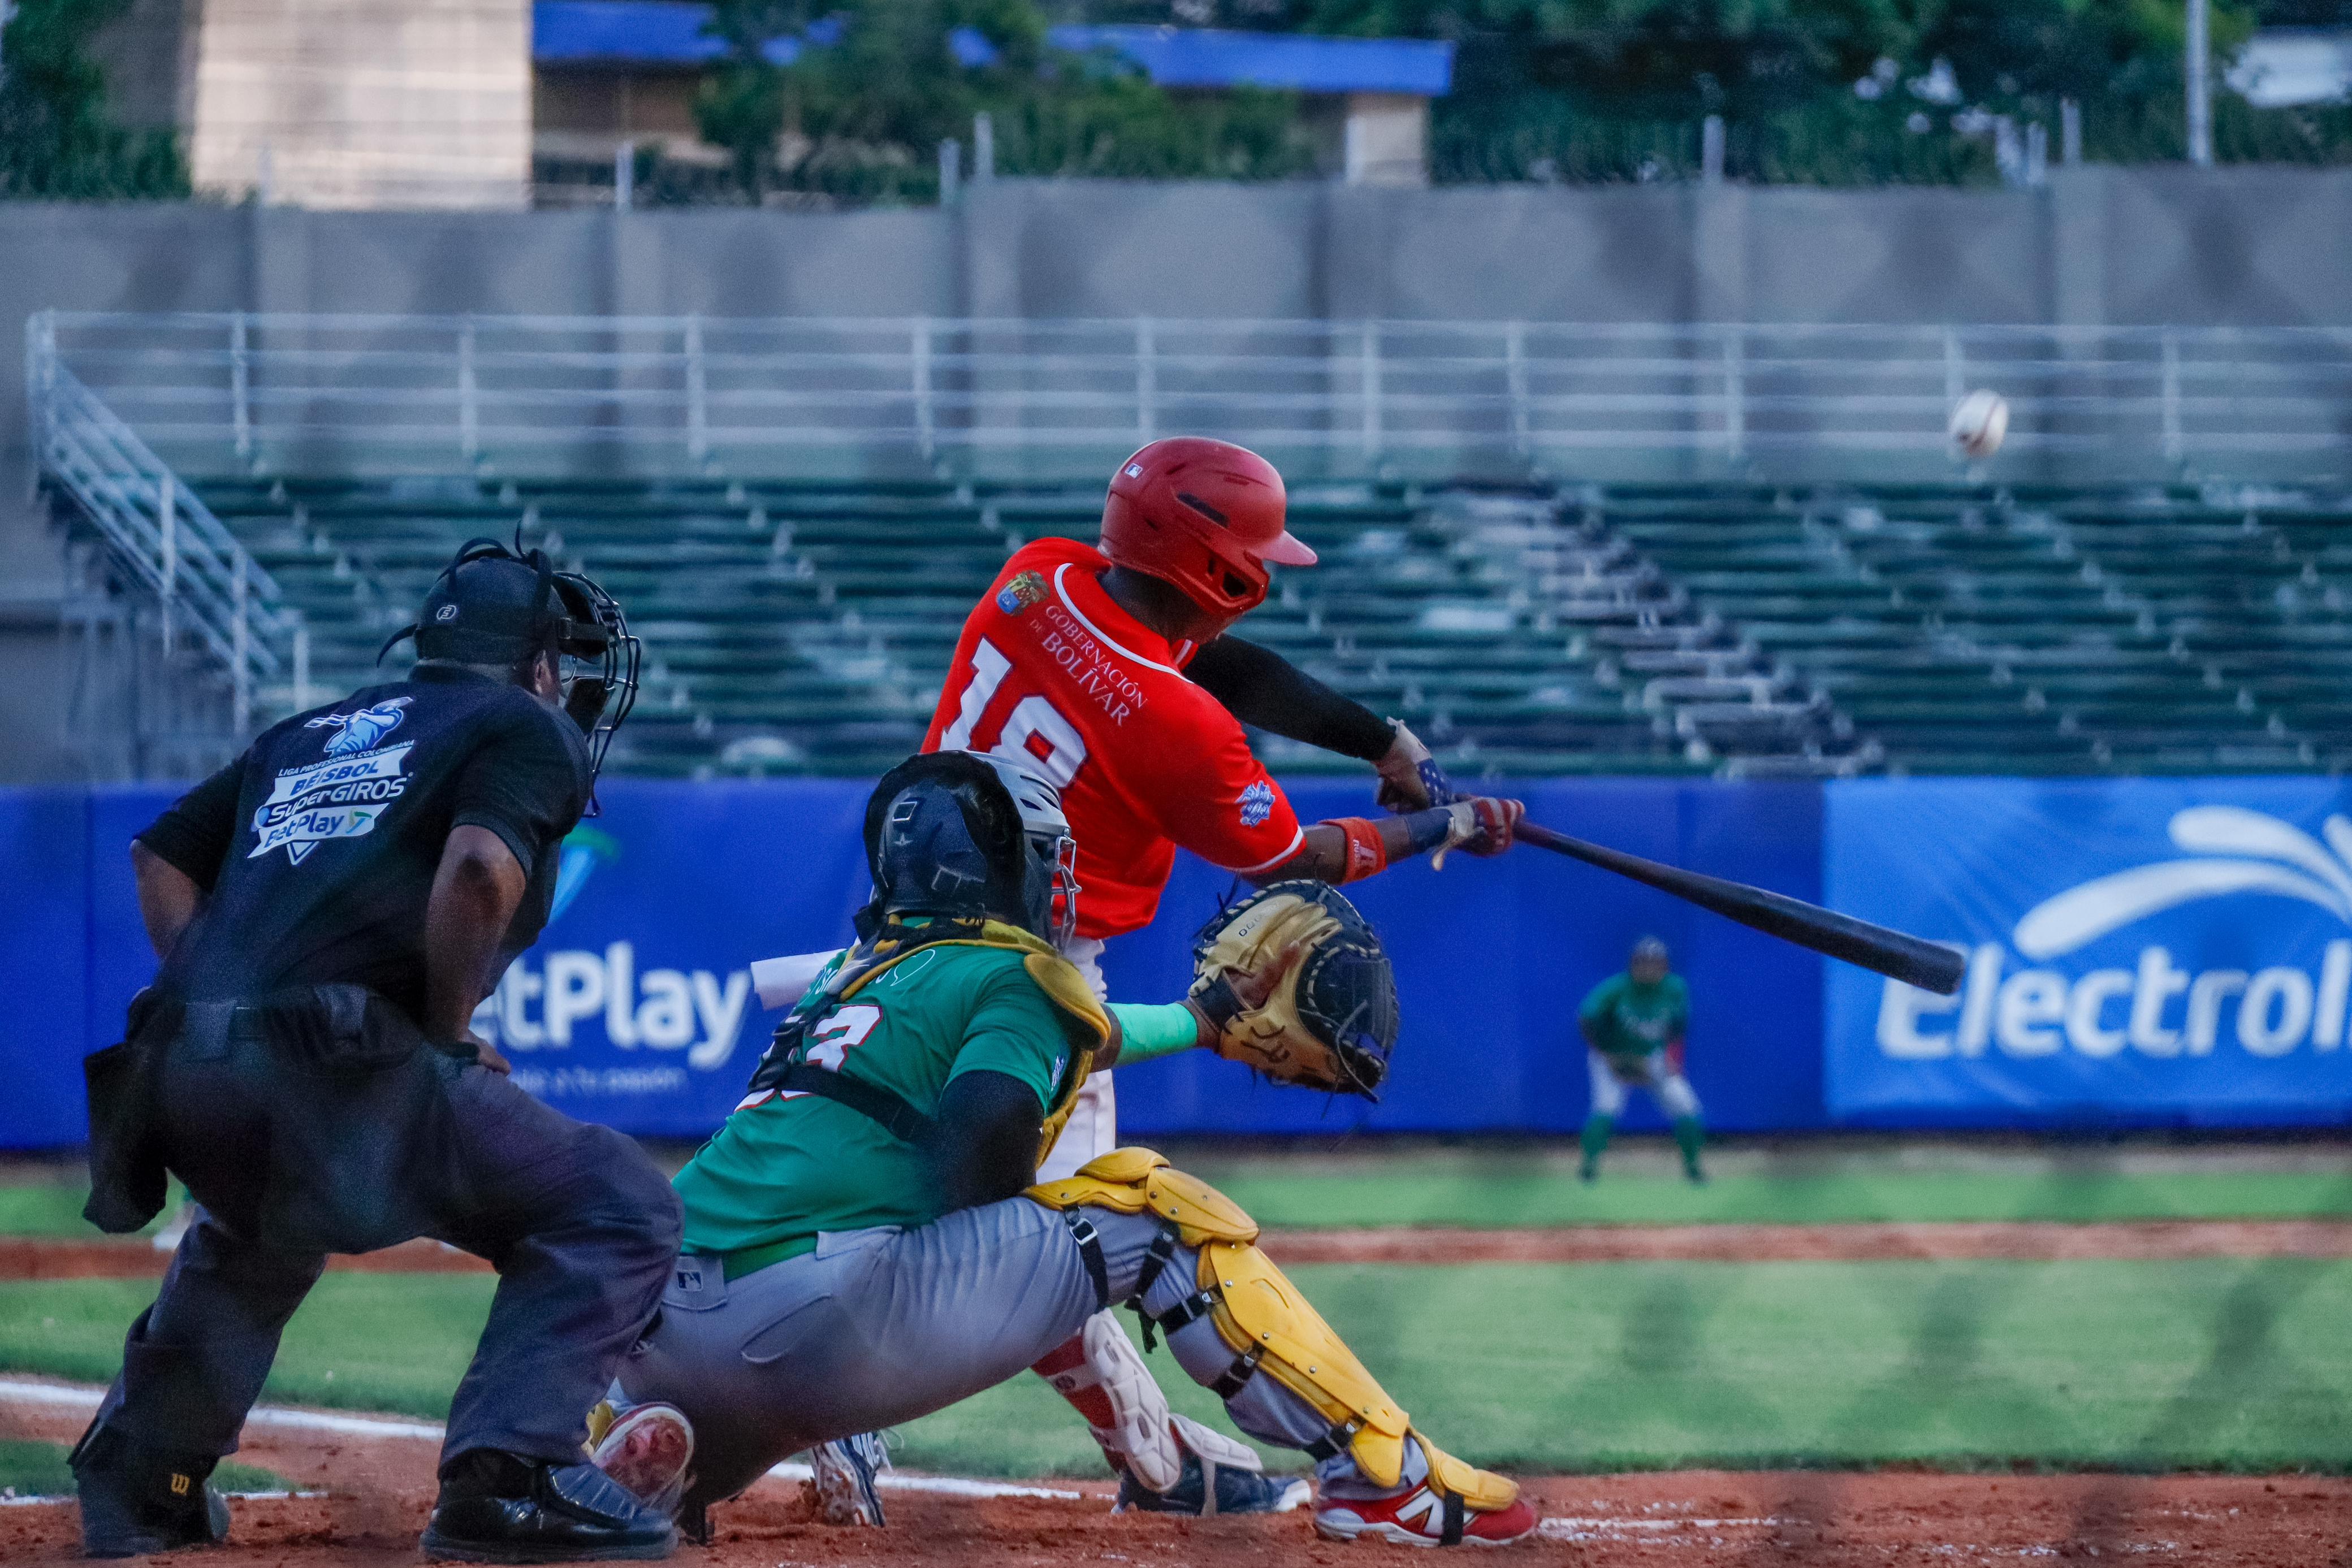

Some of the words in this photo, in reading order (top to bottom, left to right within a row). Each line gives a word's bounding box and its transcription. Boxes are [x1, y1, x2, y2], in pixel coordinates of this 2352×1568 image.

[1042, 631, 1130, 727] BOLÍVAR
[1046, 605, 1148, 708] GOBERNACIÓN
[263, 812, 344, 848] BetPlay
[1876, 939, 2352, 1058] Electrol
